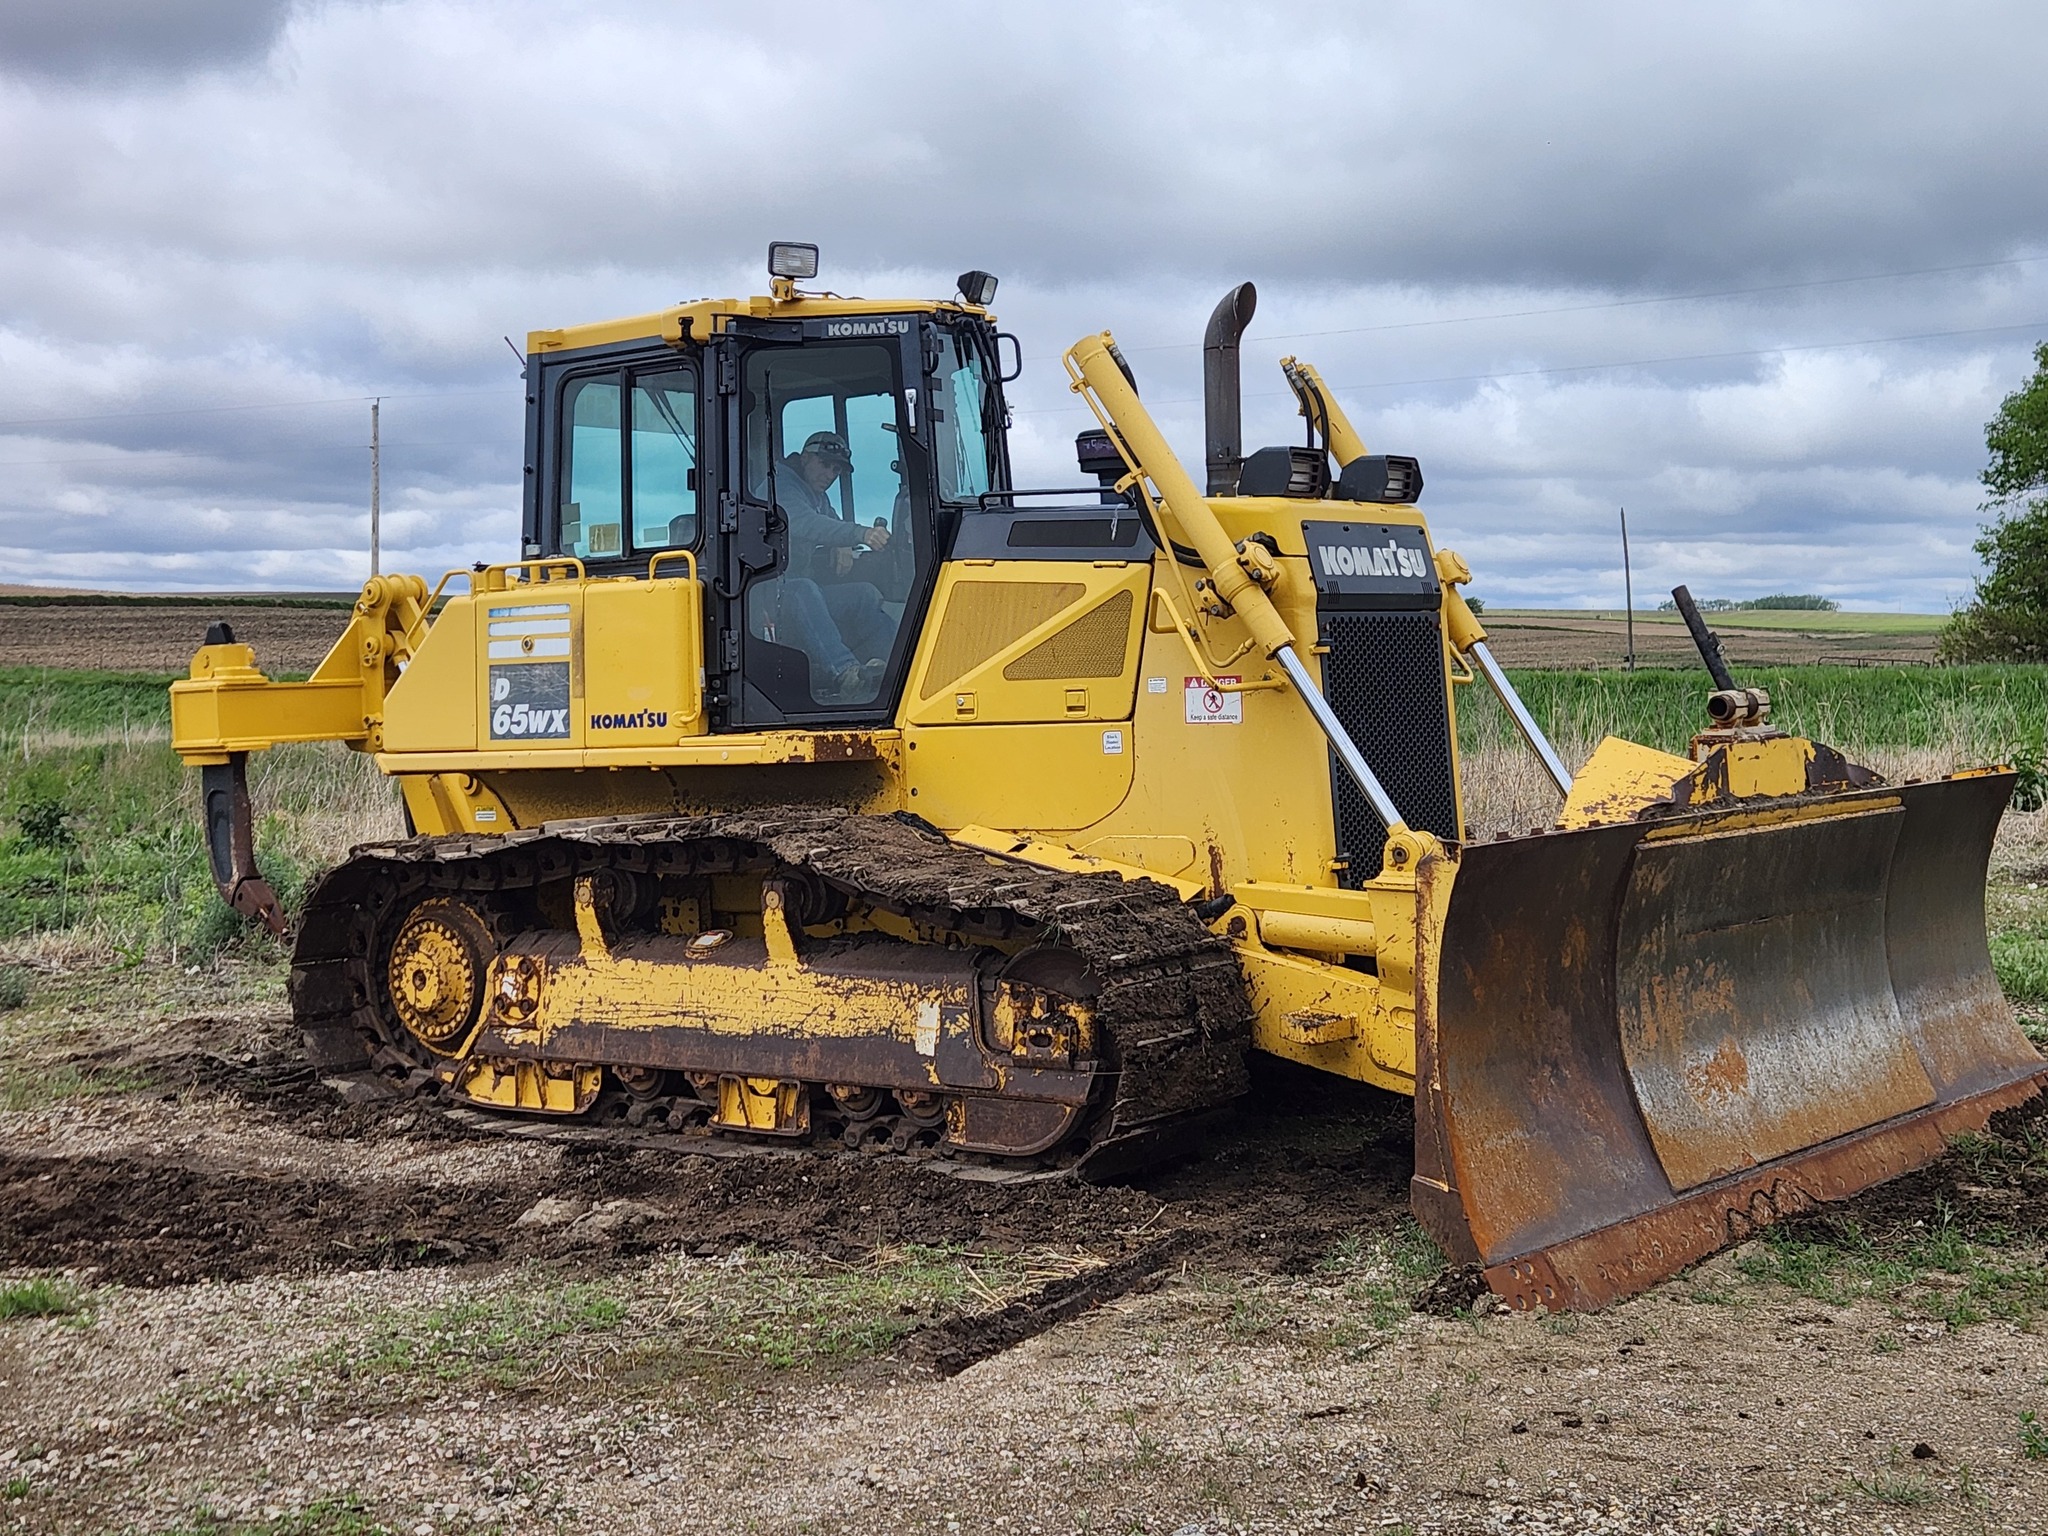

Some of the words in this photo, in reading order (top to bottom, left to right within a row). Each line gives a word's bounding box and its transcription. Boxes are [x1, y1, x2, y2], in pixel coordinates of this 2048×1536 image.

[828, 318, 909, 336] KOMATSU
[1318, 539, 1427, 578] KOMATSU
[493, 677, 510, 701] D
[1200, 678, 1237, 688] DGER
[492, 703, 568, 735] 65WX
[591, 708, 667, 729] KOMATSU
[1190, 713, 1202, 721] Keep
